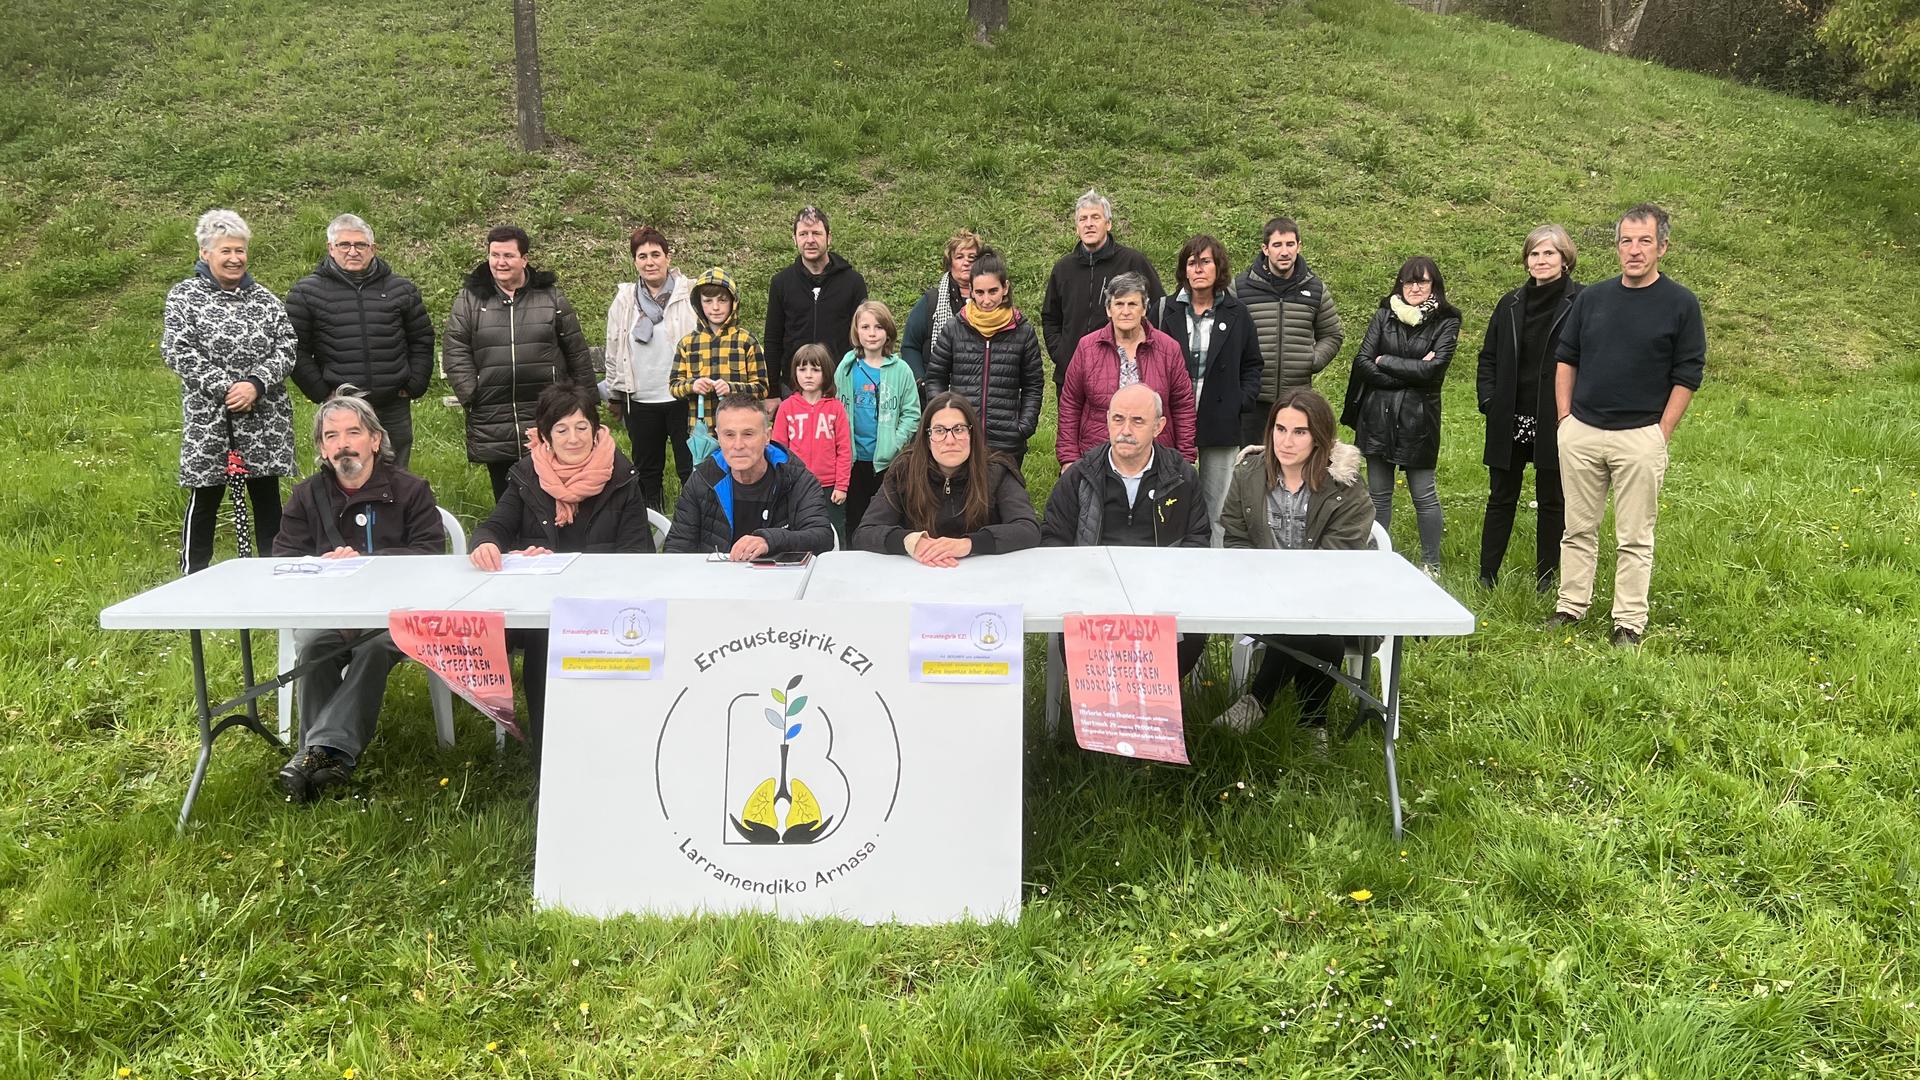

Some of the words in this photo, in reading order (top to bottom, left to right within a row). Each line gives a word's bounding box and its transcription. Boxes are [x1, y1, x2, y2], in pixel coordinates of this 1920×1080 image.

[403, 616, 488, 638] HITZALDIA
[1079, 618, 1161, 641] HITZALDIA
[416, 644, 483, 657] LARRAMENDIKO
[694, 627, 836, 673] Erraustegirik
[839, 645, 874, 676] EZ!
[1088, 649, 1154, 663] LARRAMENDIKO
[417, 657, 491, 672] USTEGIAREN
[1085, 664, 1159, 679] ERRAUSTEGIAREN
[1075, 679, 1121, 692] ONDORIOAK
[1127, 682, 1173, 696] OSASUNEAN
[679, 837, 807, 895] Larramendiko
[813, 841, 877, 888] Arnasa
